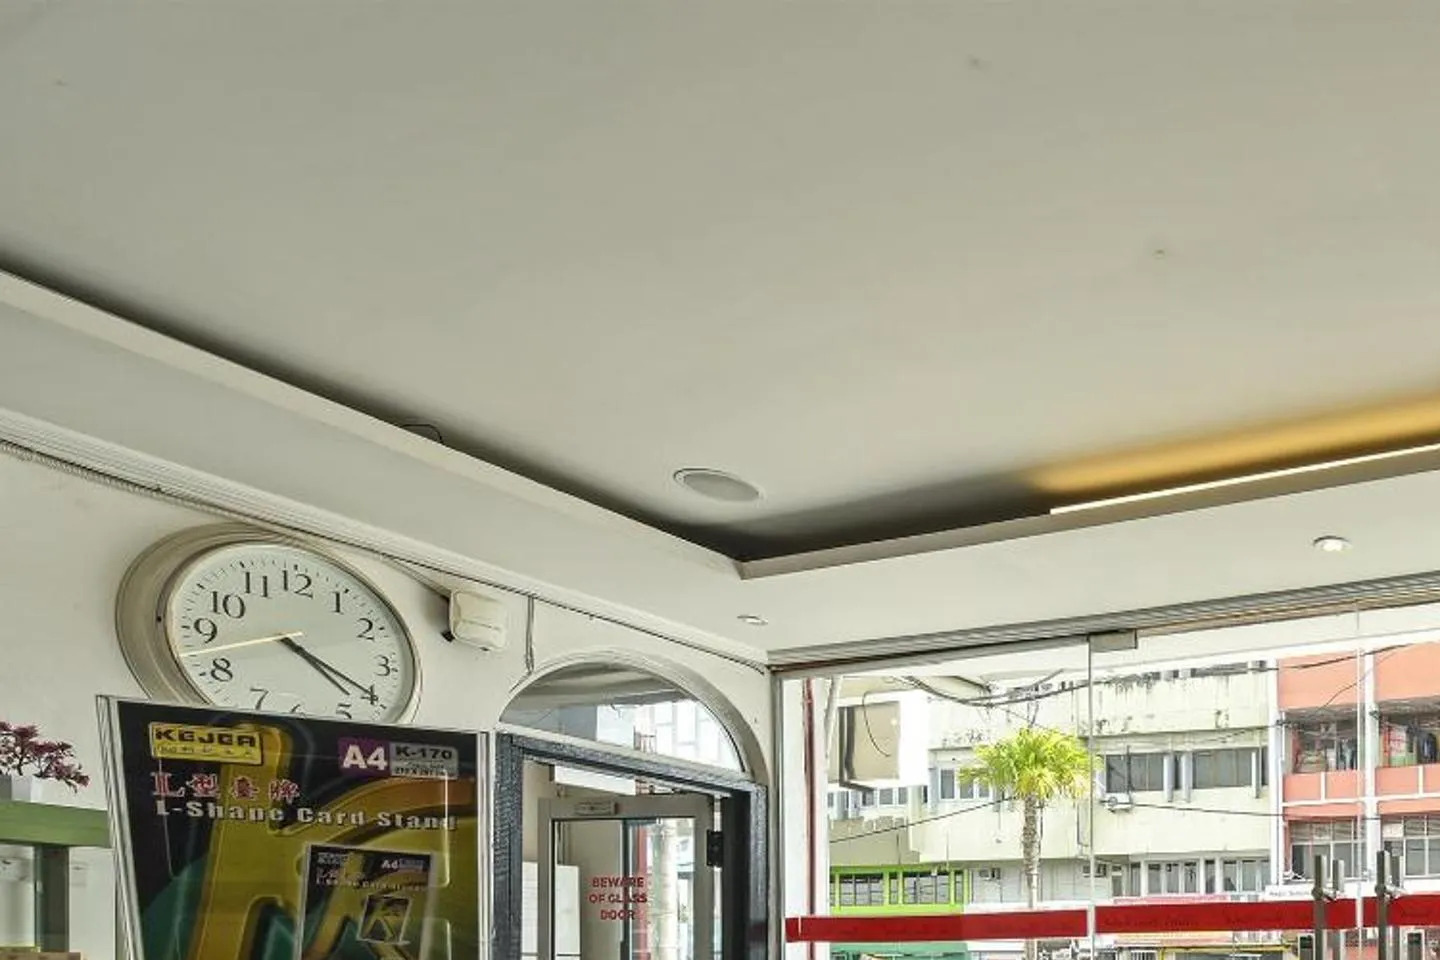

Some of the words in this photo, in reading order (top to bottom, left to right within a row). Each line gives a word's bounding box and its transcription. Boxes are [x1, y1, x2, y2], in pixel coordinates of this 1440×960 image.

[243, 571, 270, 598] 11
[281, 569, 314, 599] 12
[210, 591, 246, 619] 10
[331, 591, 345, 615] 1
[193, 617, 218, 644] 9
[357, 618, 375, 641] 2
[211, 658, 233, 683] 8
[375, 655, 391, 677] 3
[249, 688, 269, 711] 7
[361, 685, 379, 706] 4
[155, 728, 256, 747] KEJEA
[343, 743, 388, 771] A4
[395, 746, 453, 760] K-170
[297, 807, 365, 826] Card
[377, 812, 457, 830] Stand
[592, 876, 645, 888] BEWARE
[588, 893, 605, 904] OF
[600, 909, 636, 920] DOOR
